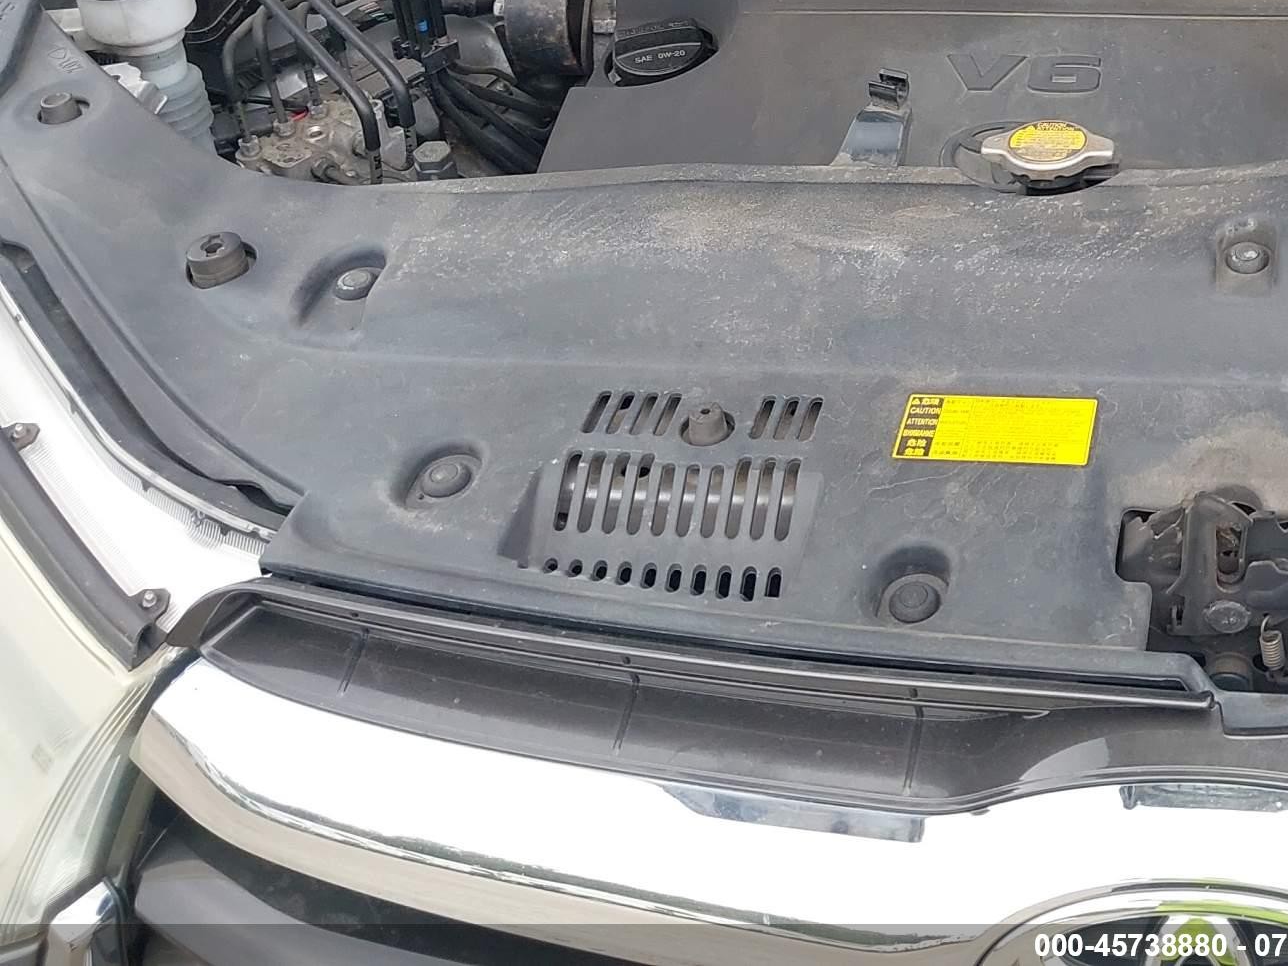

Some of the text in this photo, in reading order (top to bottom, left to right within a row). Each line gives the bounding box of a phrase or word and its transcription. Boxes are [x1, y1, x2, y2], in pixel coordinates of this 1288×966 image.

[634, 49, 686, 64] SAE 0W-20
[947, 54, 1101, 94] V6
[910, 407, 941, 415] CAUTION
[906, 418, 938, 426] ATTENTION
